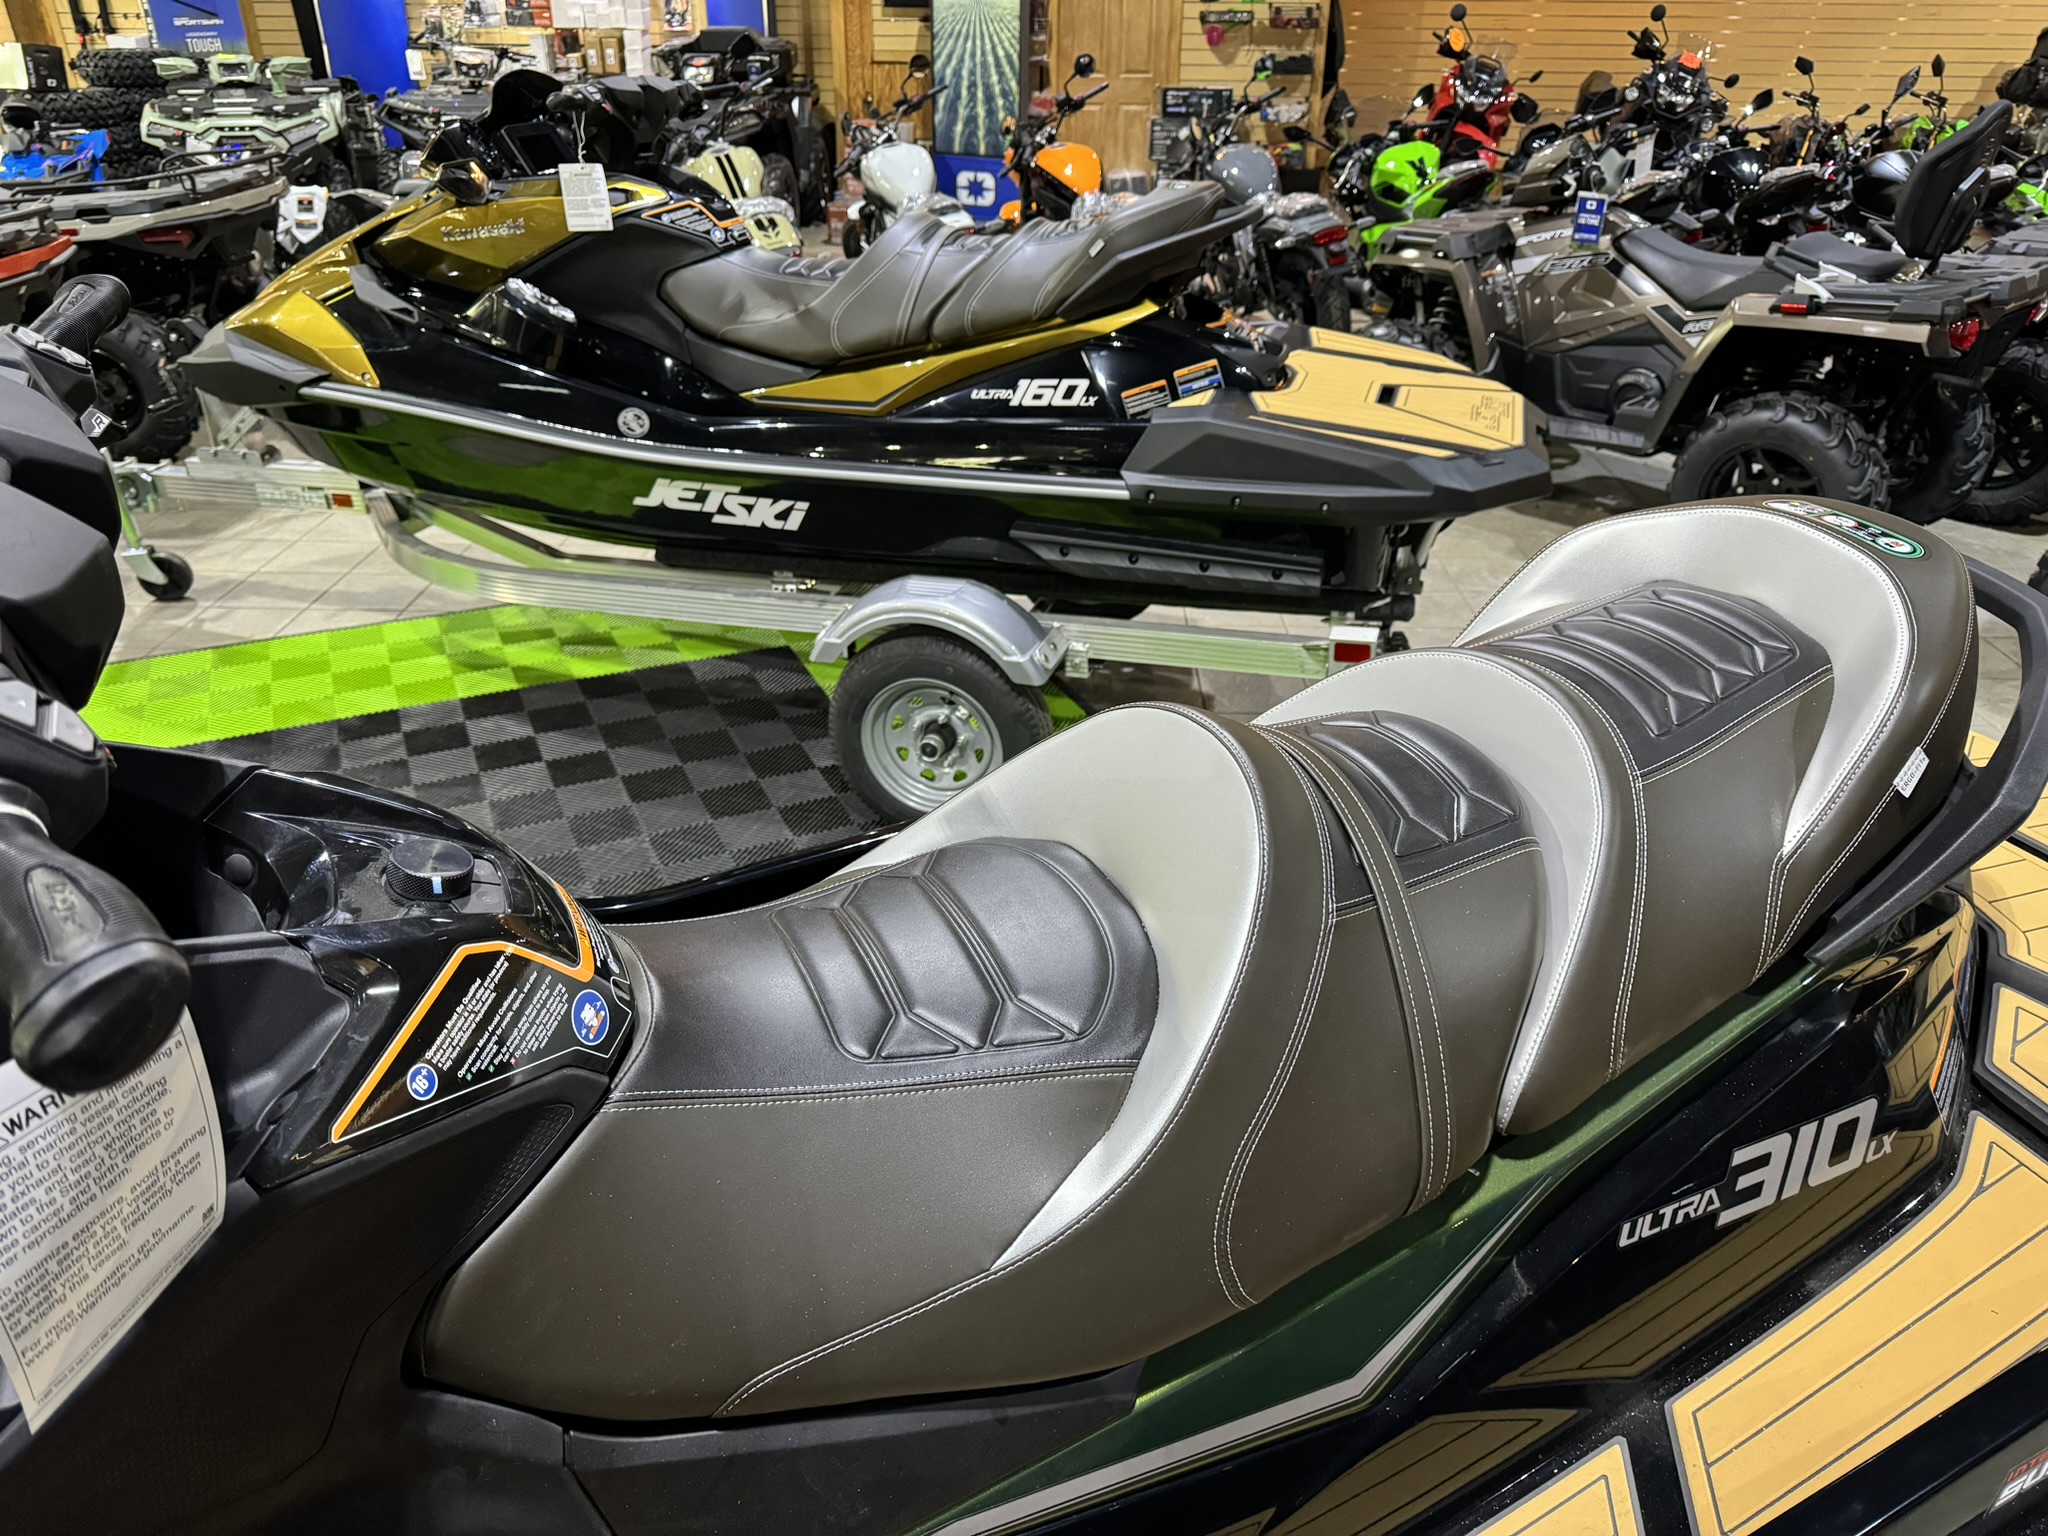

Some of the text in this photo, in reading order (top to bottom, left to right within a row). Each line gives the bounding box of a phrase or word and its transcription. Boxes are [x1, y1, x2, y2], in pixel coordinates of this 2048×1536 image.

[185, 37, 223, 53] TOUGH
[440, 217, 526, 242] Kawasaki
[970, 378, 1099, 407] ULTRA 160 LX
[632, 477, 742, 514] JET
[424, 1028, 448, 1059] Operators
[445, 1012, 459, 1029] Must
[462, 977, 481, 1004] Qualified
[431, 1048, 443, 1063] Make
[441, 1037, 451, 1049] sure
[449, 1015, 465, 1038] operator
[475, 985, 484, 999] older
[439, 1044, 453, 1063] boater
[451, 1029, 465, 1046] safety
[461, 1013, 475, 1030] course.
[472, 1000, 482, 1012] Your
[481, 988, 490, 1001] state
[493, 960, 509, 983] province)
[449, 1045, 460, 1059] have
[458, 1021, 476, 1047] additional
[474, 992, 496, 1023] requirements.
[457, 987, 517, 1077] Operators Must Avoid Collisions
[470, 1059, 481, 1073] Scan
[480, 1034, 498, 1059] constantly
[500, 1010, 514, 1029] people,
[511, 992, 525, 1010] objects,
[528, 970, 537, 983] other
[493, 1052, 503, 1065] Stay
[506, 1027, 519, 1046] enough
[517, 1014, 527, 1028] away
[524, 1003, 533, 1015] from
[532, 989, 542, 1004] others
[508, 1035, 520, 1052] always
[519, 1021, 529, 1036] safely
[527, 1007, 537, 1022] coast
[541, 988, 550, 1000] stop.
[525, 1024, 537, 1041] release
[535, 1007, 547, 1024] throttle
[545, 995, 554, 1008] when
[552, 982, 562, 996] trying
[527, 1035, 536, 1049] steer
[534, 1023, 544, 1036] away
[541, 1012, 550, 1024] from
[549, 996, 560, 1013] objects
[531, 1040, 539, 1051] with
[538, 1028, 546, 1041] other
[539, 1035, 548, 1048] need
[546, 1019, 558, 1036] throttle
[18, 1111, 78, 1158] servicing
[174, 1039, 182, 1049] a
[480, 1044, 498, 1069] watercraft.
[7, 1169, 33, 1193] you
[35, 1159, 49, 1172] to
[53, 1114, 114, 1160] chemicals
[116, 1076, 166, 1116] including
[10, 1163, 67, 1208] exhaust,
[69, 1129, 111, 1163] carbon
[113, 1087, 171, 1131] monoxide,
[32, 1122, 77, 1160] marine
[79, 1094, 119, 1127] vessel
[121, 1080, 143, 1099] can
[44, 1171, 69, 1195] and
[70, 1150, 101, 1175] lead,
[102, 1123, 136, 1151] which
[139, 1108, 157, 1125] are
[14, 1240, 69, 1287] minimize
[72, 1196, 127, 1241] exposure,
[130, 1164, 158, 1194] avoid
[160, 1125, 206, 1168] breathing
[19, 1107, 174, 1226] to the State of California to
[22, 1203, 64, 1239] cancer
[69, 1181, 91, 1205] and
[92, 1162, 119, 1186] birth
[121, 1129, 161, 1164] defects
[163, 1117, 173, 1131] or
[1618, 1097, 1898, 1248] ULTRA 310 LX
[1, 1158, 181, 1311] exhaust, service your vessel in a
[5, 1246, 89, 1321] well-ventilated
[92, 1225, 117, 1249] area
[120, 1202, 140, 1225] and
[142, 1181, 166, 1205] wear
[169, 1151, 200, 1184] gloves
[9, 1317, 21, 1331] or
[25, 1288, 57, 1317] wash
[59, 1263, 84, 1291] your
[87, 1232, 121, 1265] hands
[123, 1186, 173, 1233] frequently
[174, 1161, 200, 1186] when
[22, 1192, 97, 1253] reproductive
[98, 1167, 131, 1194] harm.
[13, 1292, 66, 1340] servicing
[68, 1272, 89, 1292] this
[20, 1337, 41, 1359] For
[44, 1309, 74, 1338] more
[77, 1253, 135, 1308] information
[136, 1239, 150, 1255] go
[151, 1227, 161, 1239] to
